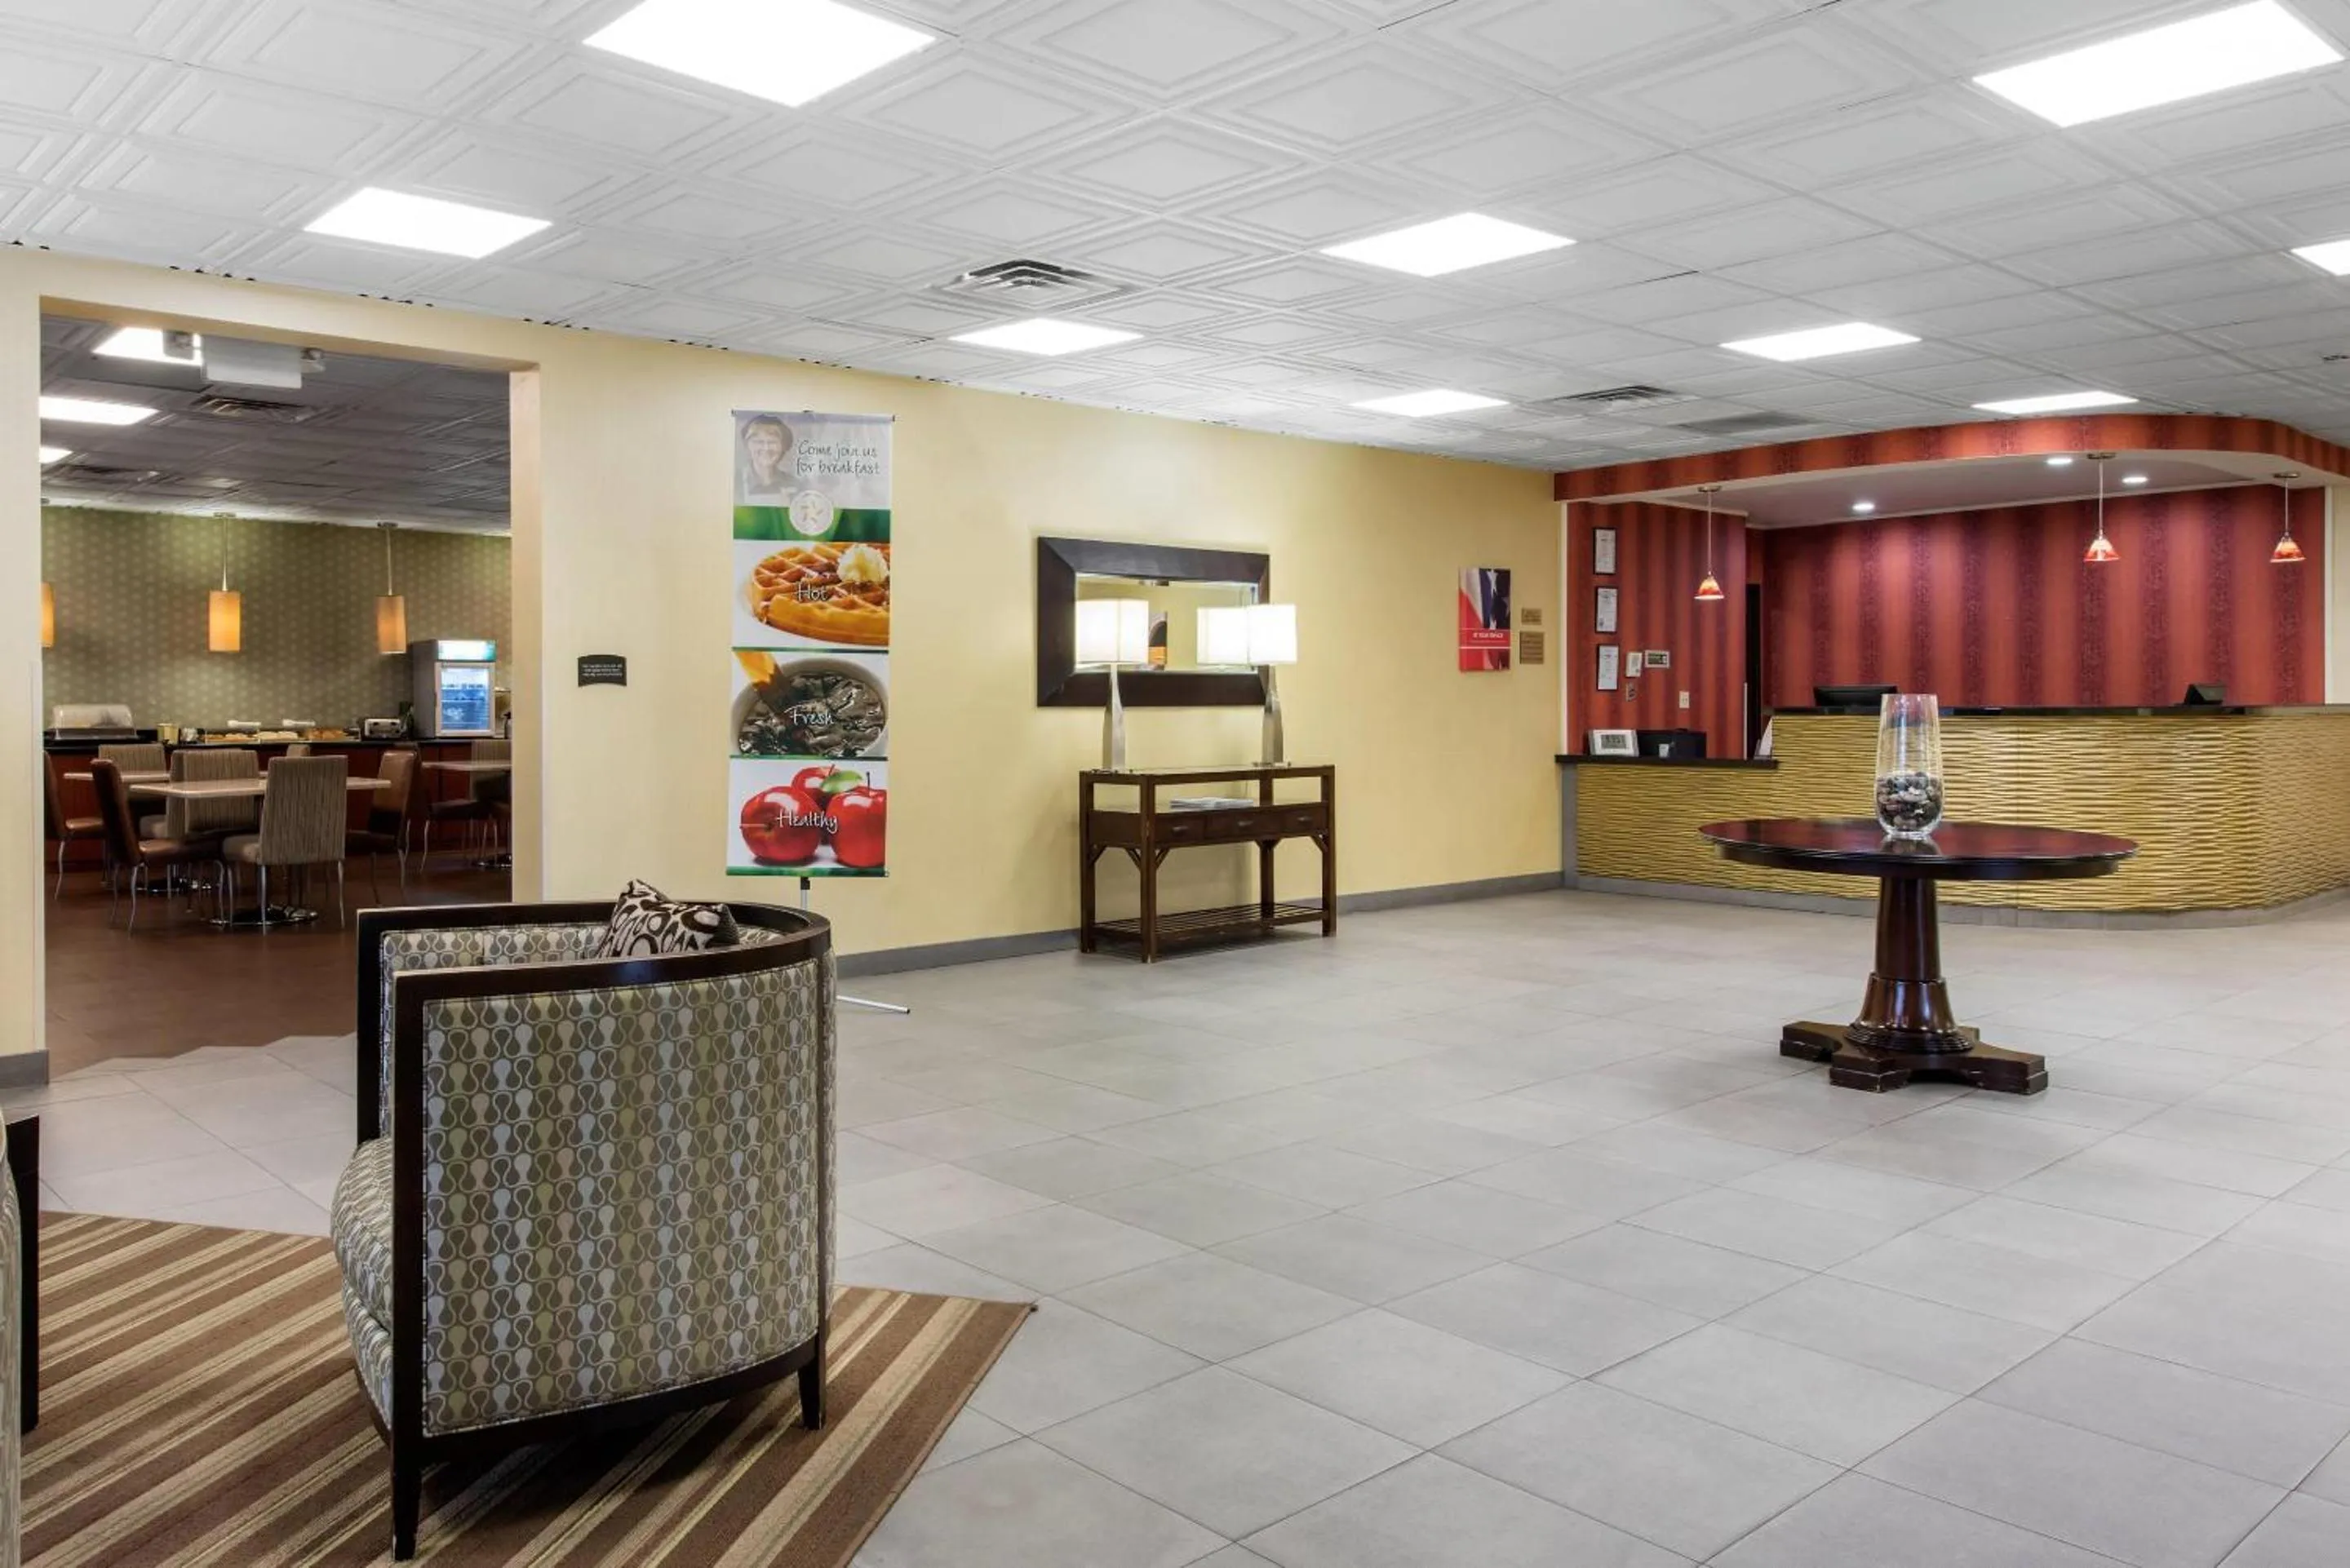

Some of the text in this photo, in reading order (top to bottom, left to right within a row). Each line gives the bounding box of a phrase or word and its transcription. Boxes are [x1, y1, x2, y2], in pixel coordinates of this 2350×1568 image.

[799, 440, 878, 462] Come join us
[796, 457, 880, 479] for breakfast
[796, 581, 828, 601] Hot
[783, 704, 835, 725] Fresh
[776, 808, 838, 834] Healthy
